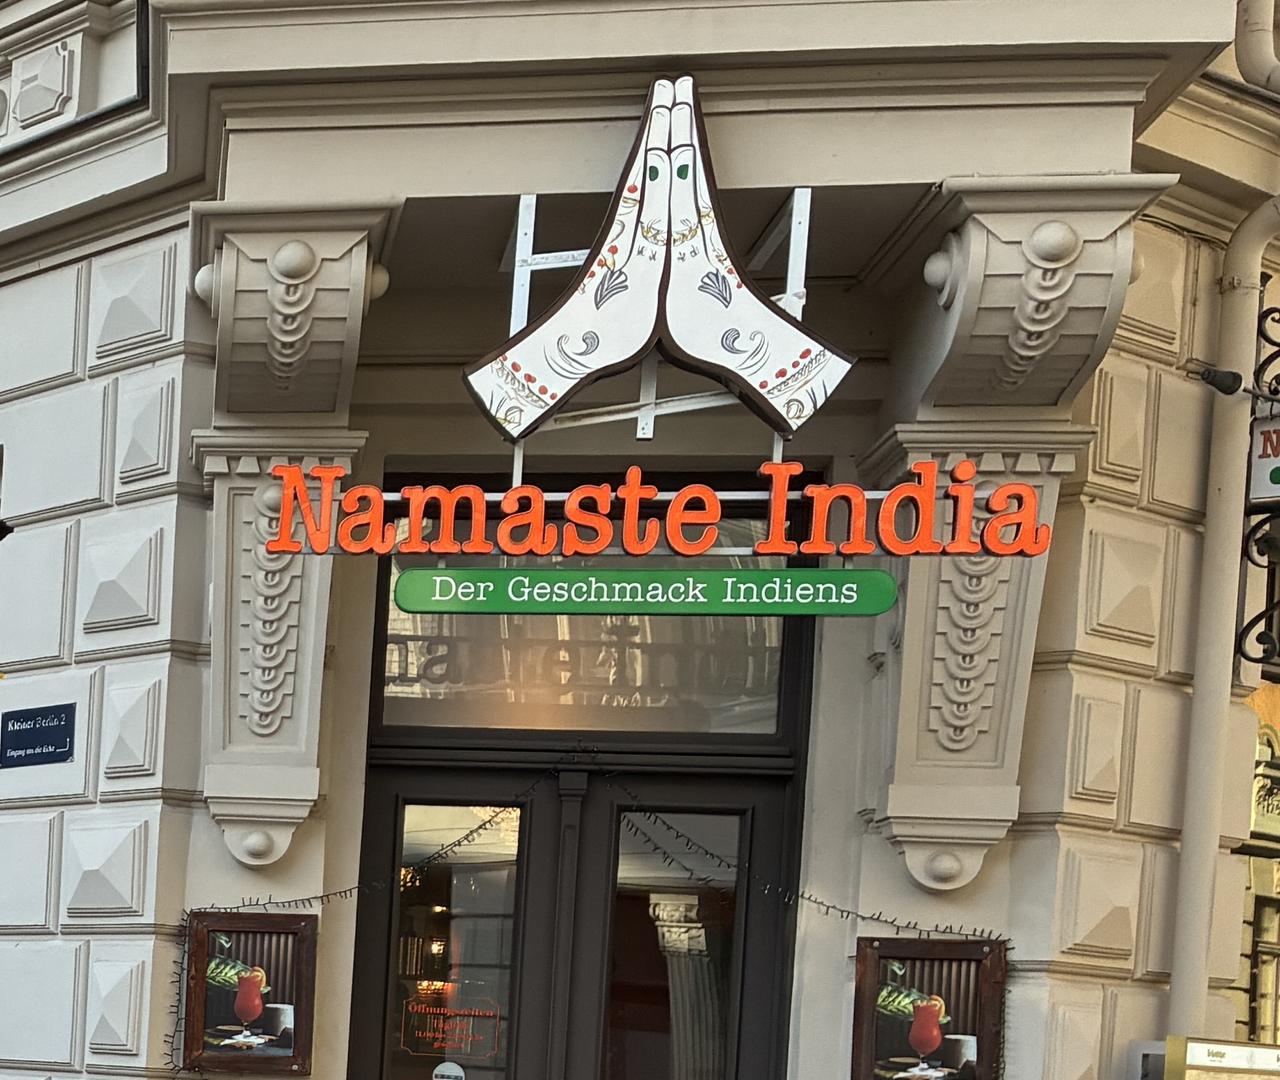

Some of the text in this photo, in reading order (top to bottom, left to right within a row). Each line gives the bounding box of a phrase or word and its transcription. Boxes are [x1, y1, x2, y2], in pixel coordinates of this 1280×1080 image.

[266, 459, 1050, 558] Namaste India
[431, 576, 858, 605] Der Geschmack Indiens
[8, 718, 35, 731] Kleiner
[36, 714, 59, 728] Berlin
